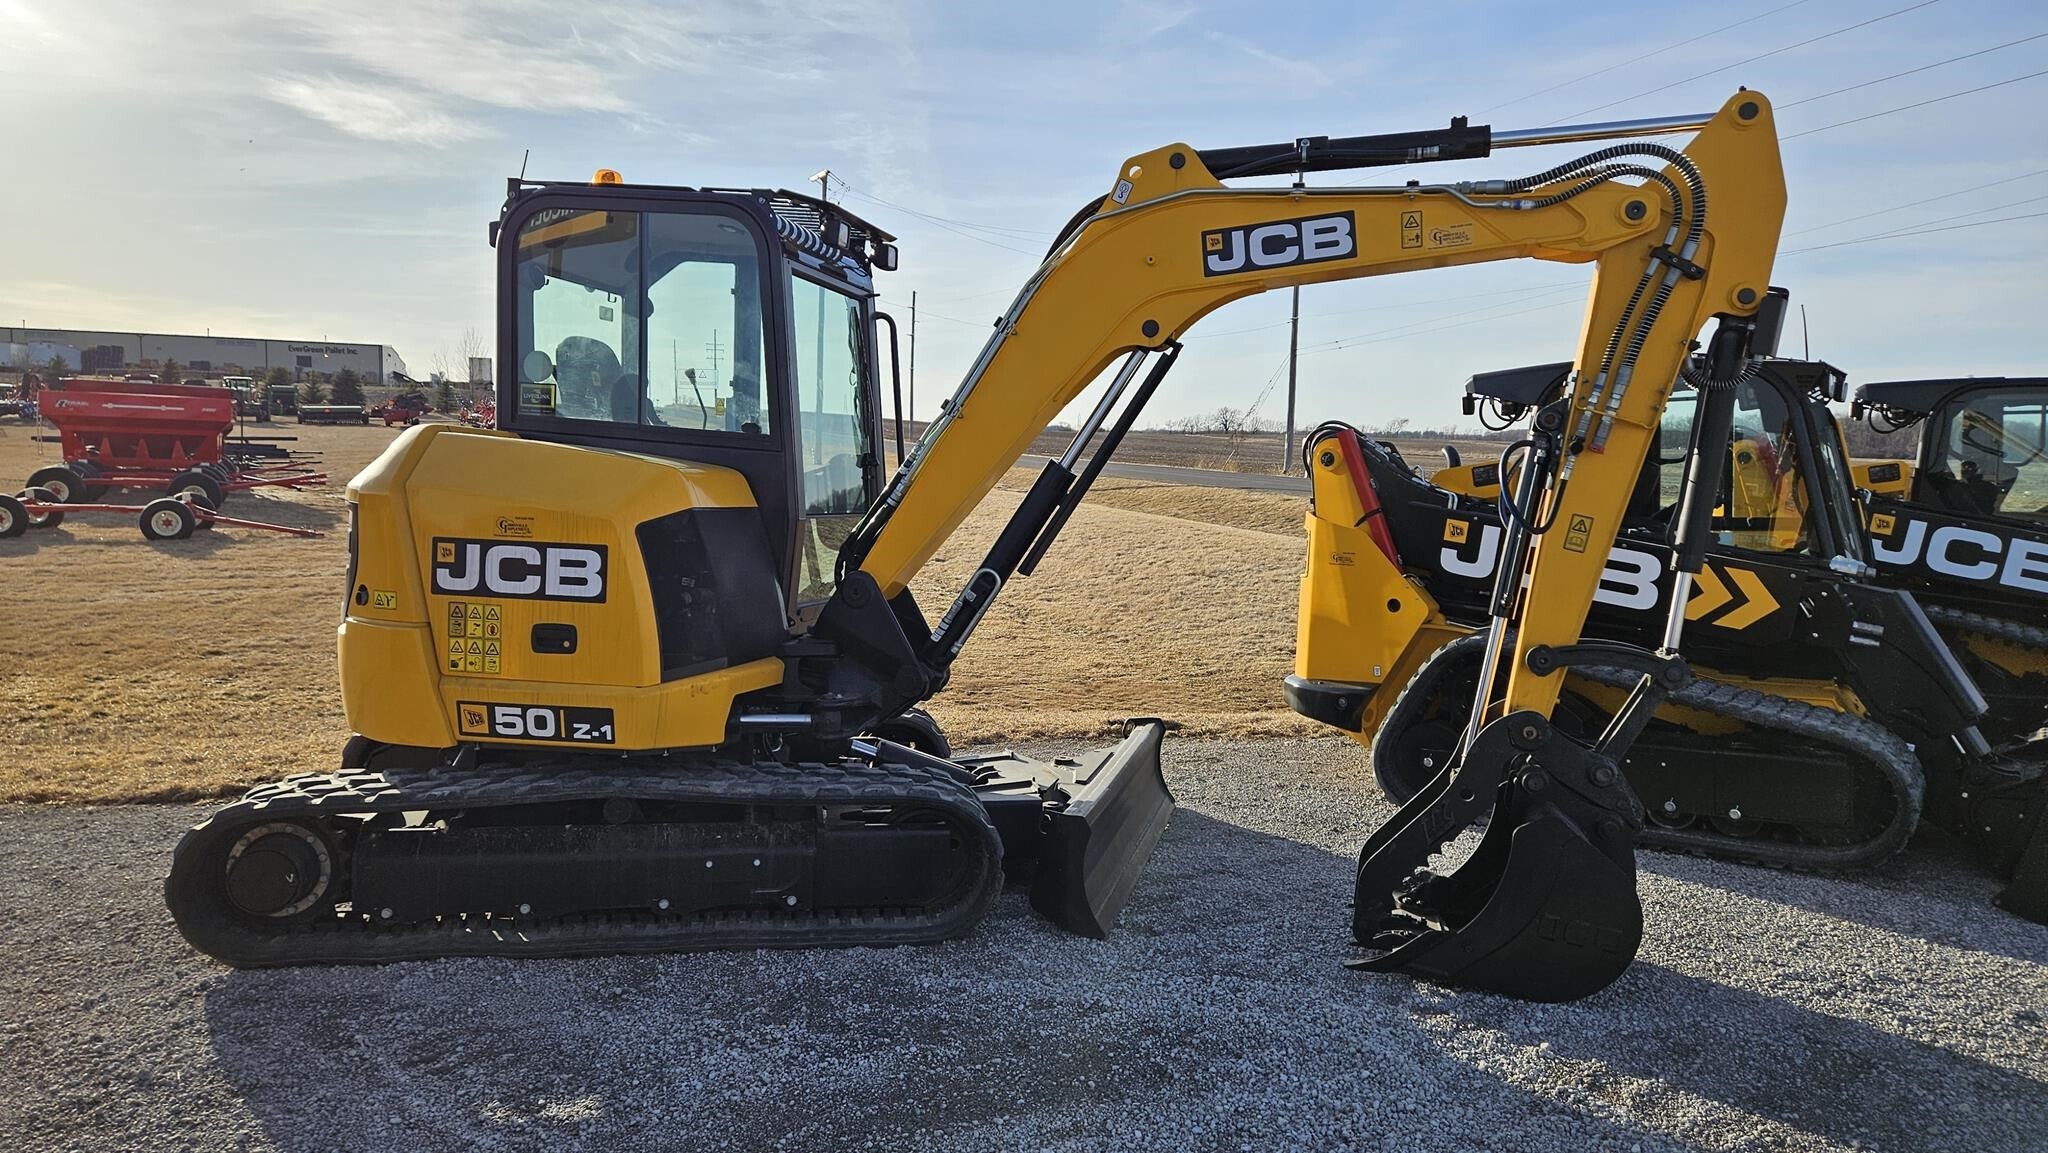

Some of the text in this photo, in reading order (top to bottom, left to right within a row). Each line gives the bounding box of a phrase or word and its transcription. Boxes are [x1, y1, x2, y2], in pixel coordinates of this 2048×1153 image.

[1207, 217, 1353, 272] JCB
[325, 346, 345, 354] Pallet
[436, 543, 602, 597] JCB
[1440, 525, 1662, 610] JB
[465, 710, 485, 727] JCB
[495, 706, 612, 740] 50 Z-1
